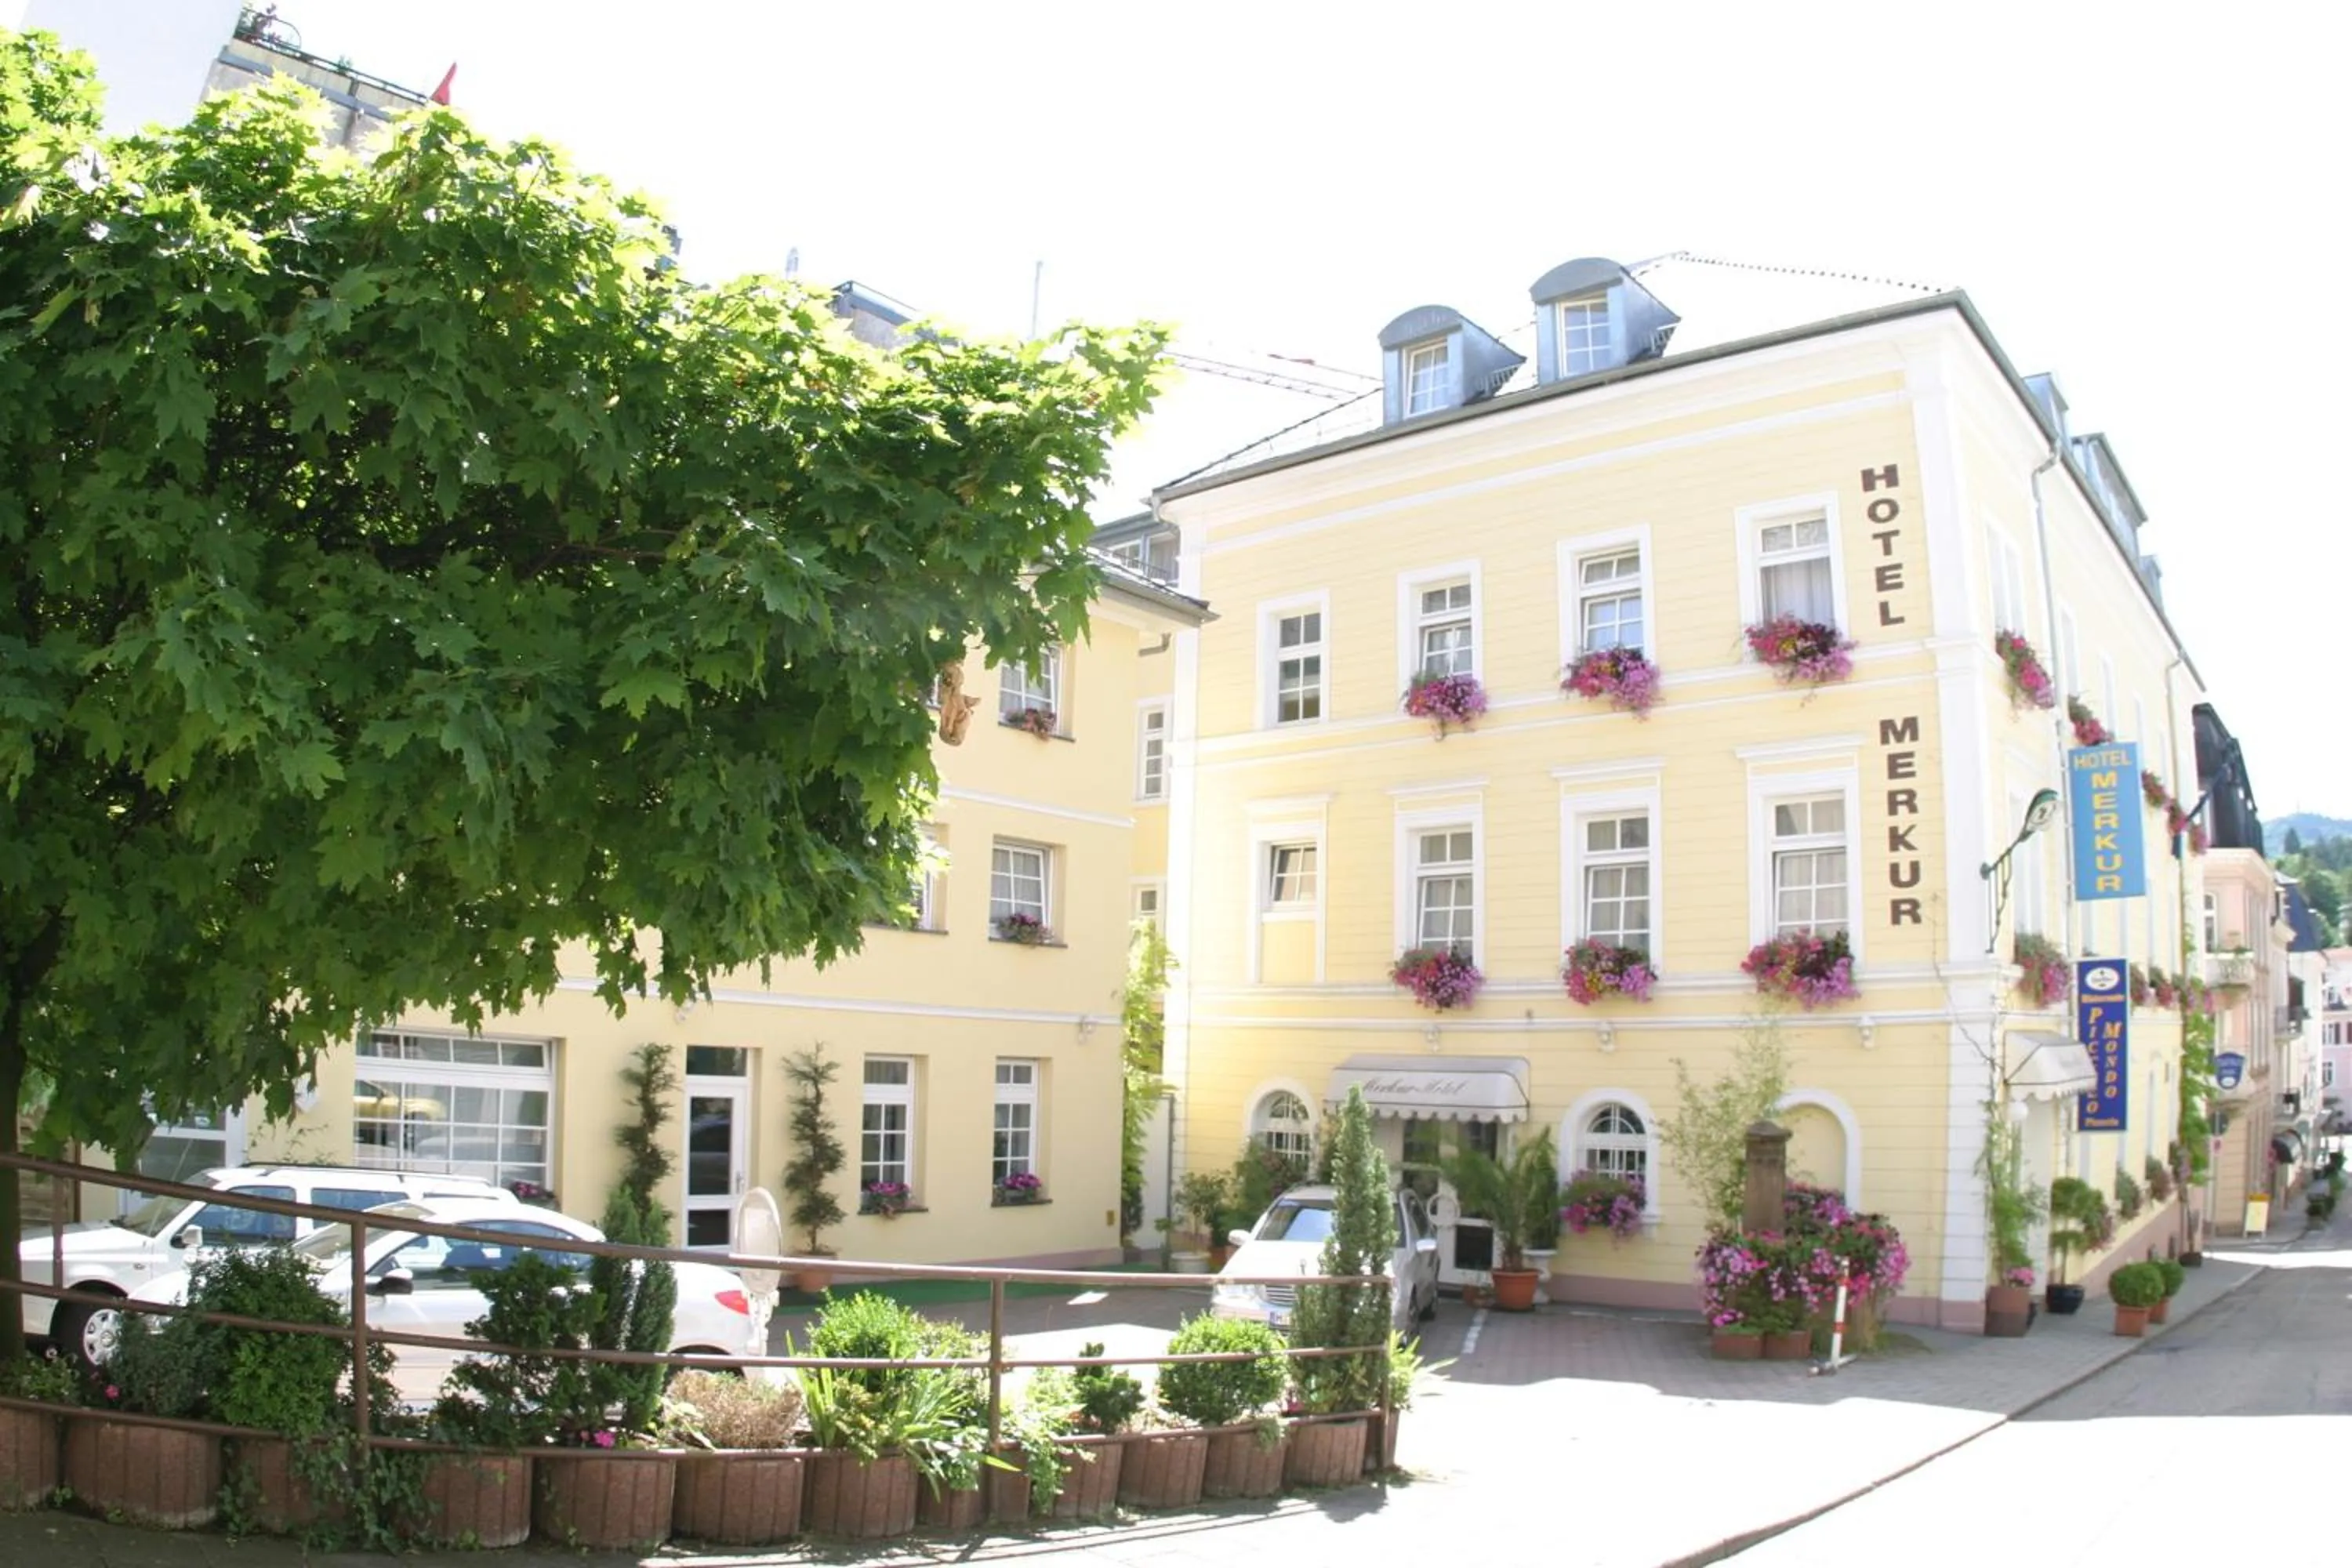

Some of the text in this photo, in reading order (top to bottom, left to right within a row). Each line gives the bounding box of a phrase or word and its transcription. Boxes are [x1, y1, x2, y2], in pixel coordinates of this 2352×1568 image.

[1860, 463, 1905, 627] HOTEL
[1879, 716, 1922, 927] MERKUR
[2074, 750, 2132, 771] HOTEL
[2091, 770, 2123, 893] MERKUR
[2103, 1022, 2122, 1099] MONDO
